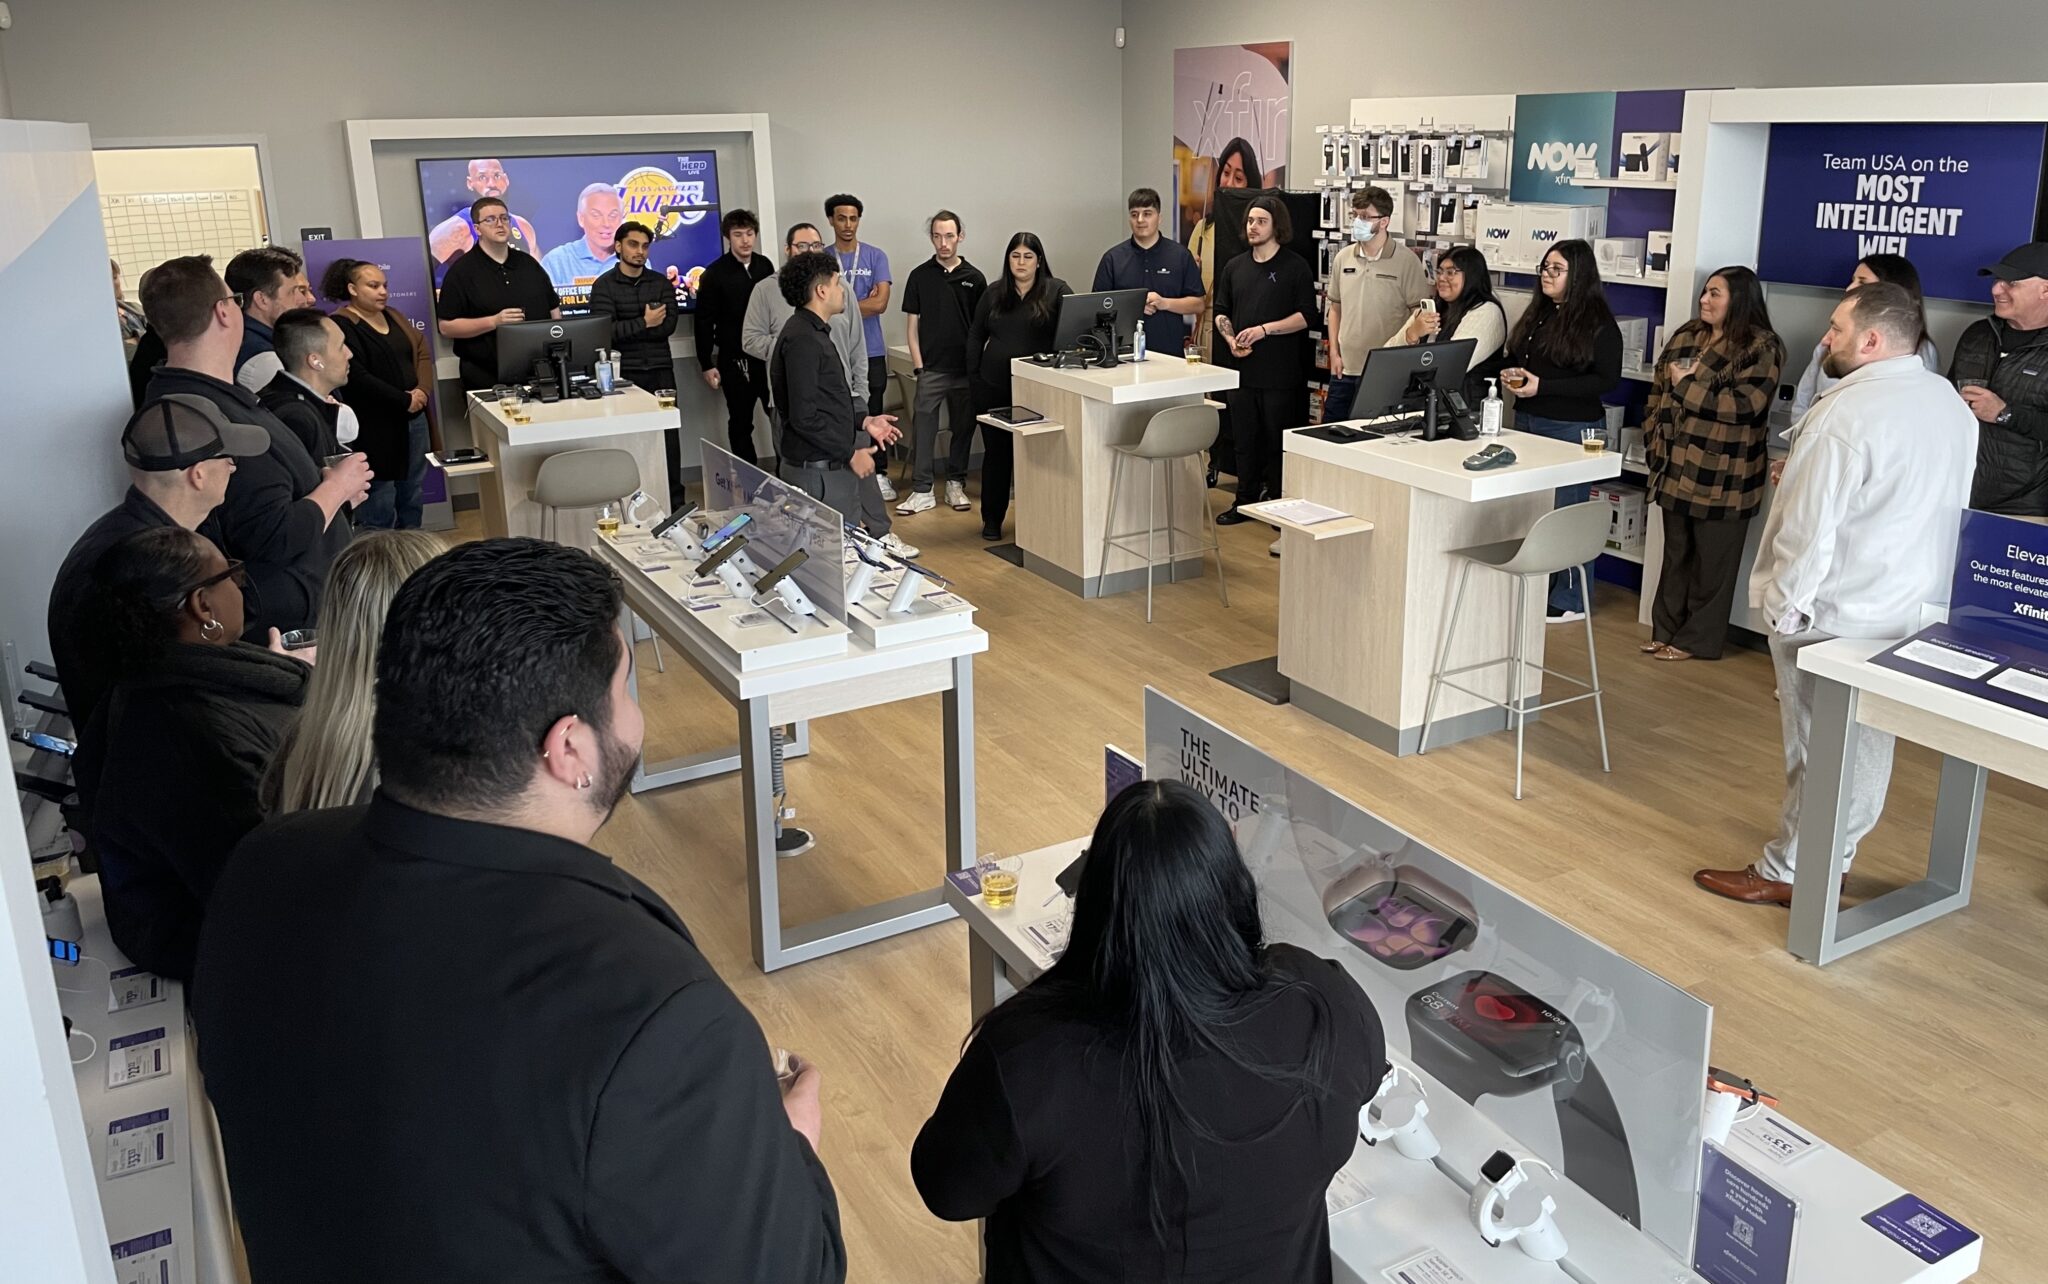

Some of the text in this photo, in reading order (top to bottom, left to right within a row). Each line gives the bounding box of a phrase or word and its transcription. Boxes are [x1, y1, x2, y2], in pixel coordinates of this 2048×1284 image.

[681, 161, 706, 170] HERD
[1527, 142, 1598, 171] NOW
[1823, 154, 1969, 173] Team USA on the
[1856, 174, 1925, 203] MOST
[1816, 202, 1963, 236] INTELLIGENT
[1486, 228, 1510, 240] NOW
[1532, 229, 1558, 241] NOW
[1858, 234, 1907, 260] WIFI
[562, 296, 575, 304] FOR
[1970, 560, 1988, 571] Our
[1990, 564, 2010, 577] best
[1973, 573, 1989, 584] the
[1990, 578, 2013, 590] most
[1181, 727, 1210, 762] THE
[1181, 749, 1259, 814] ULTIMATE
[1181, 769, 1239, 822] WAY TO
[1420, 994, 1444, 1010] 68
[1431, 991, 1460, 1010] Current
[1541, 1009, 1566, 1026] 10:09
[1724, 1168, 1772, 1204] Discover how to
[1725, 1192, 1767, 1225] Xfinity Mobile
[1735, 1192, 1749, 1204] year
[1749, 1202, 1763, 1214] with
[1740, 1187, 1769, 1210] hundreds
[1900, 1239, 1922, 1253] xfinity
